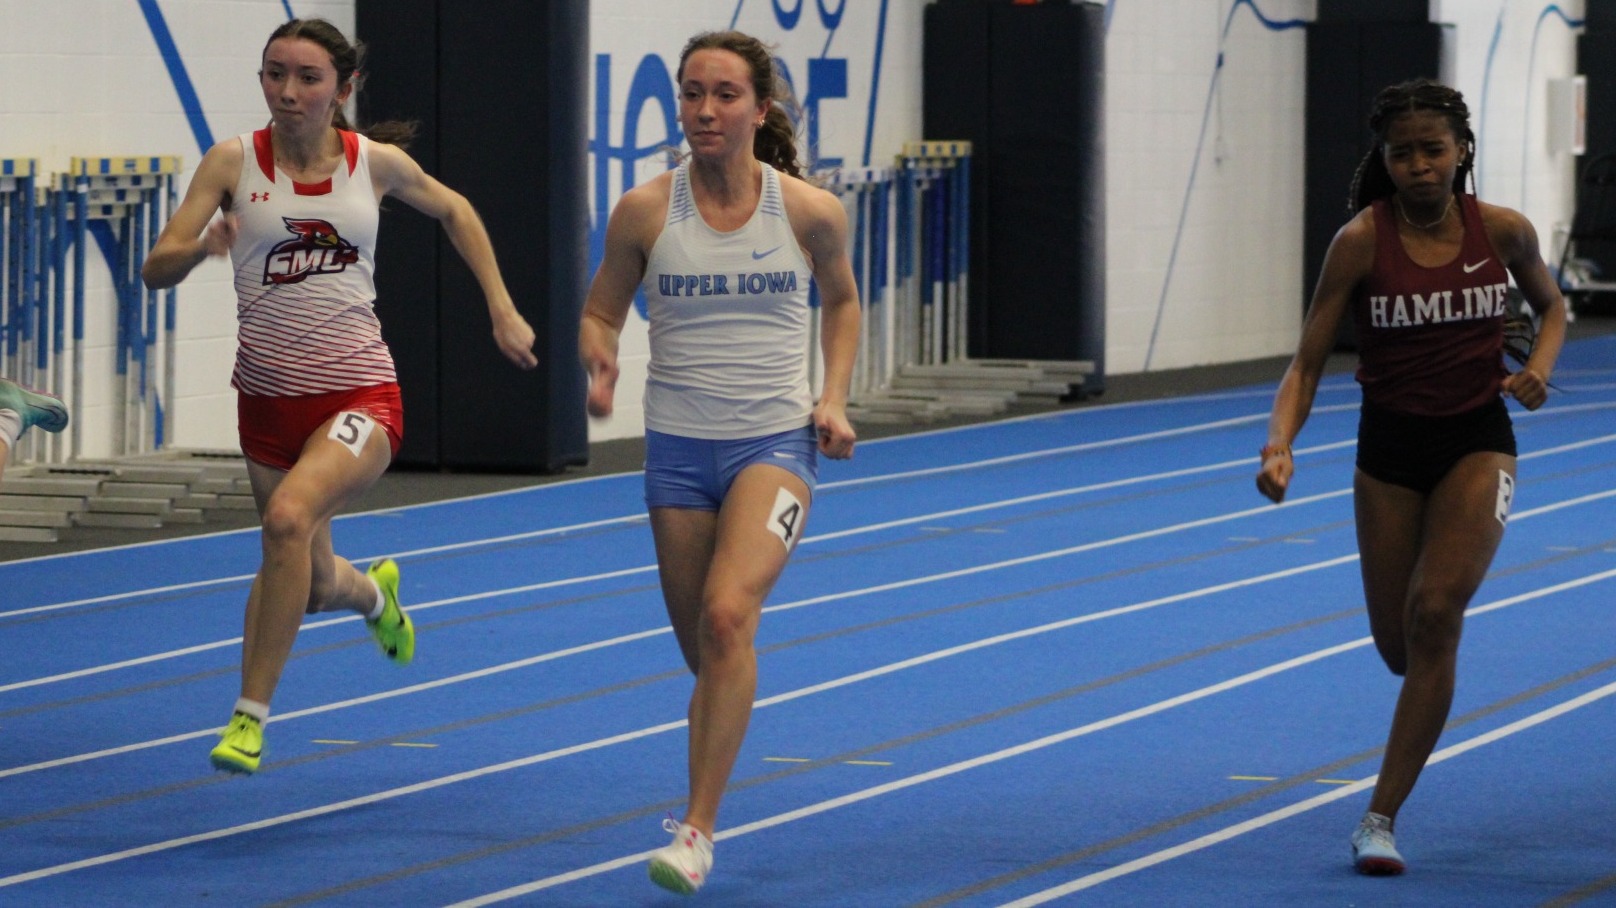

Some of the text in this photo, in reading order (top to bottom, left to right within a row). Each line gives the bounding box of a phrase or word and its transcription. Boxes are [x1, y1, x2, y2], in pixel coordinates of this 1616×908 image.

[658, 270, 798, 297] UPPER IOWA
[1370, 282, 1508, 328] HAMLINE
[336, 413, 367, 445] 5
[777, 502, 800, 542] 4
